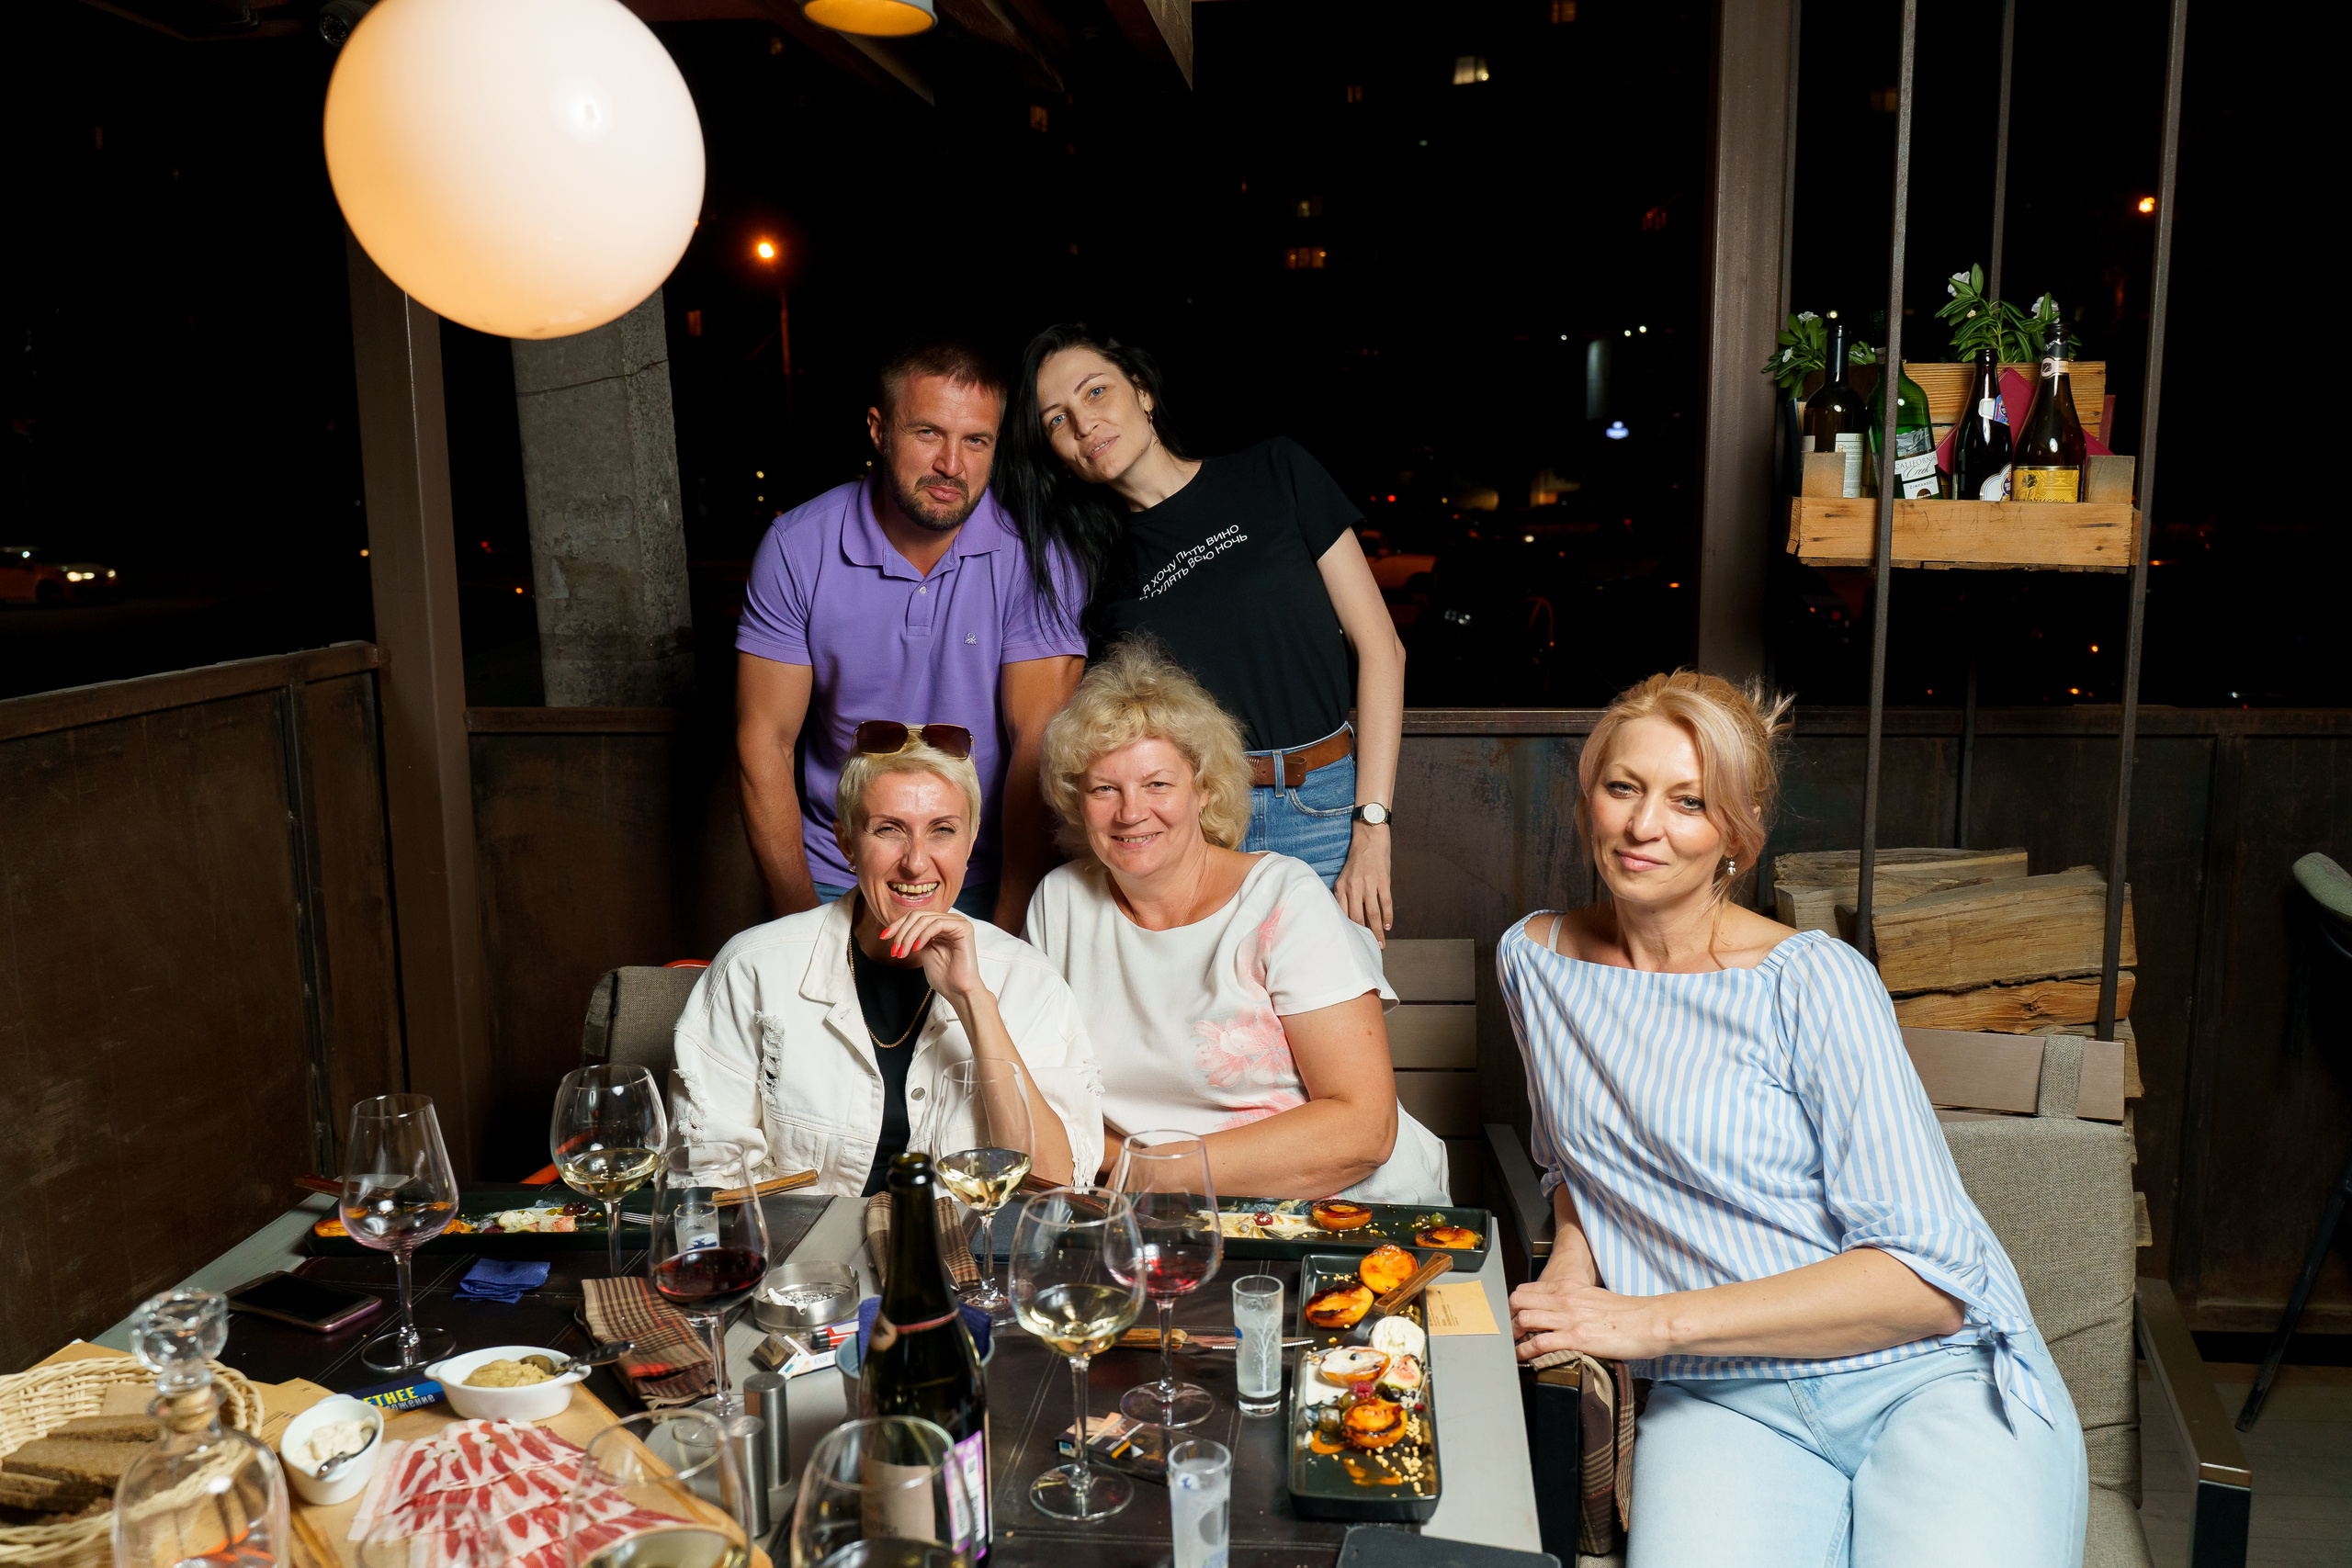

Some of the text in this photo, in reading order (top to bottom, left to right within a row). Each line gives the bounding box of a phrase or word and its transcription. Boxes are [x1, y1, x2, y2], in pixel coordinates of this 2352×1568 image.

[1895, 455, 1936, 469] CALIFORNIA
[1143, 584, 1150, 594] Я
[1151, 559, 1176, 587] ХОЧУ
[1205, 525, 1239, 547] ВИНО
[1151, 534, 1248, 597] ГУЛЯТЬ ВСЮ НОЧЬ
[363, 1386, 418, 1406] ЕТНЕЕ
